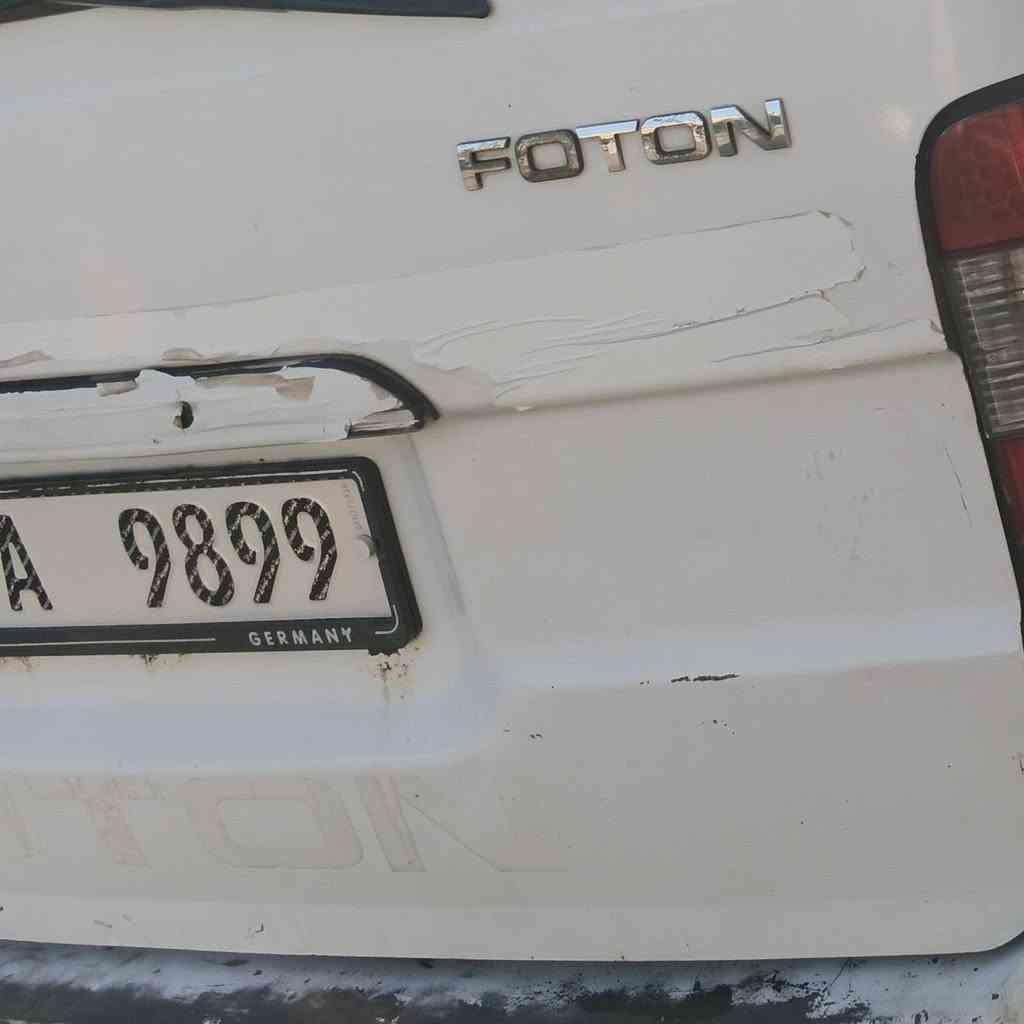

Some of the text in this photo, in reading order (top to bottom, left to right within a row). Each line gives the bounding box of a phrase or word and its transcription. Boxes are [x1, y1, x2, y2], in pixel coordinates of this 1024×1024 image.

[456, 97, 792, 191] FOTON
[0, 514, 53, 611] A
[118, 497, 338, 609] 9899
[247, 626, 354, 647] GERMANY
